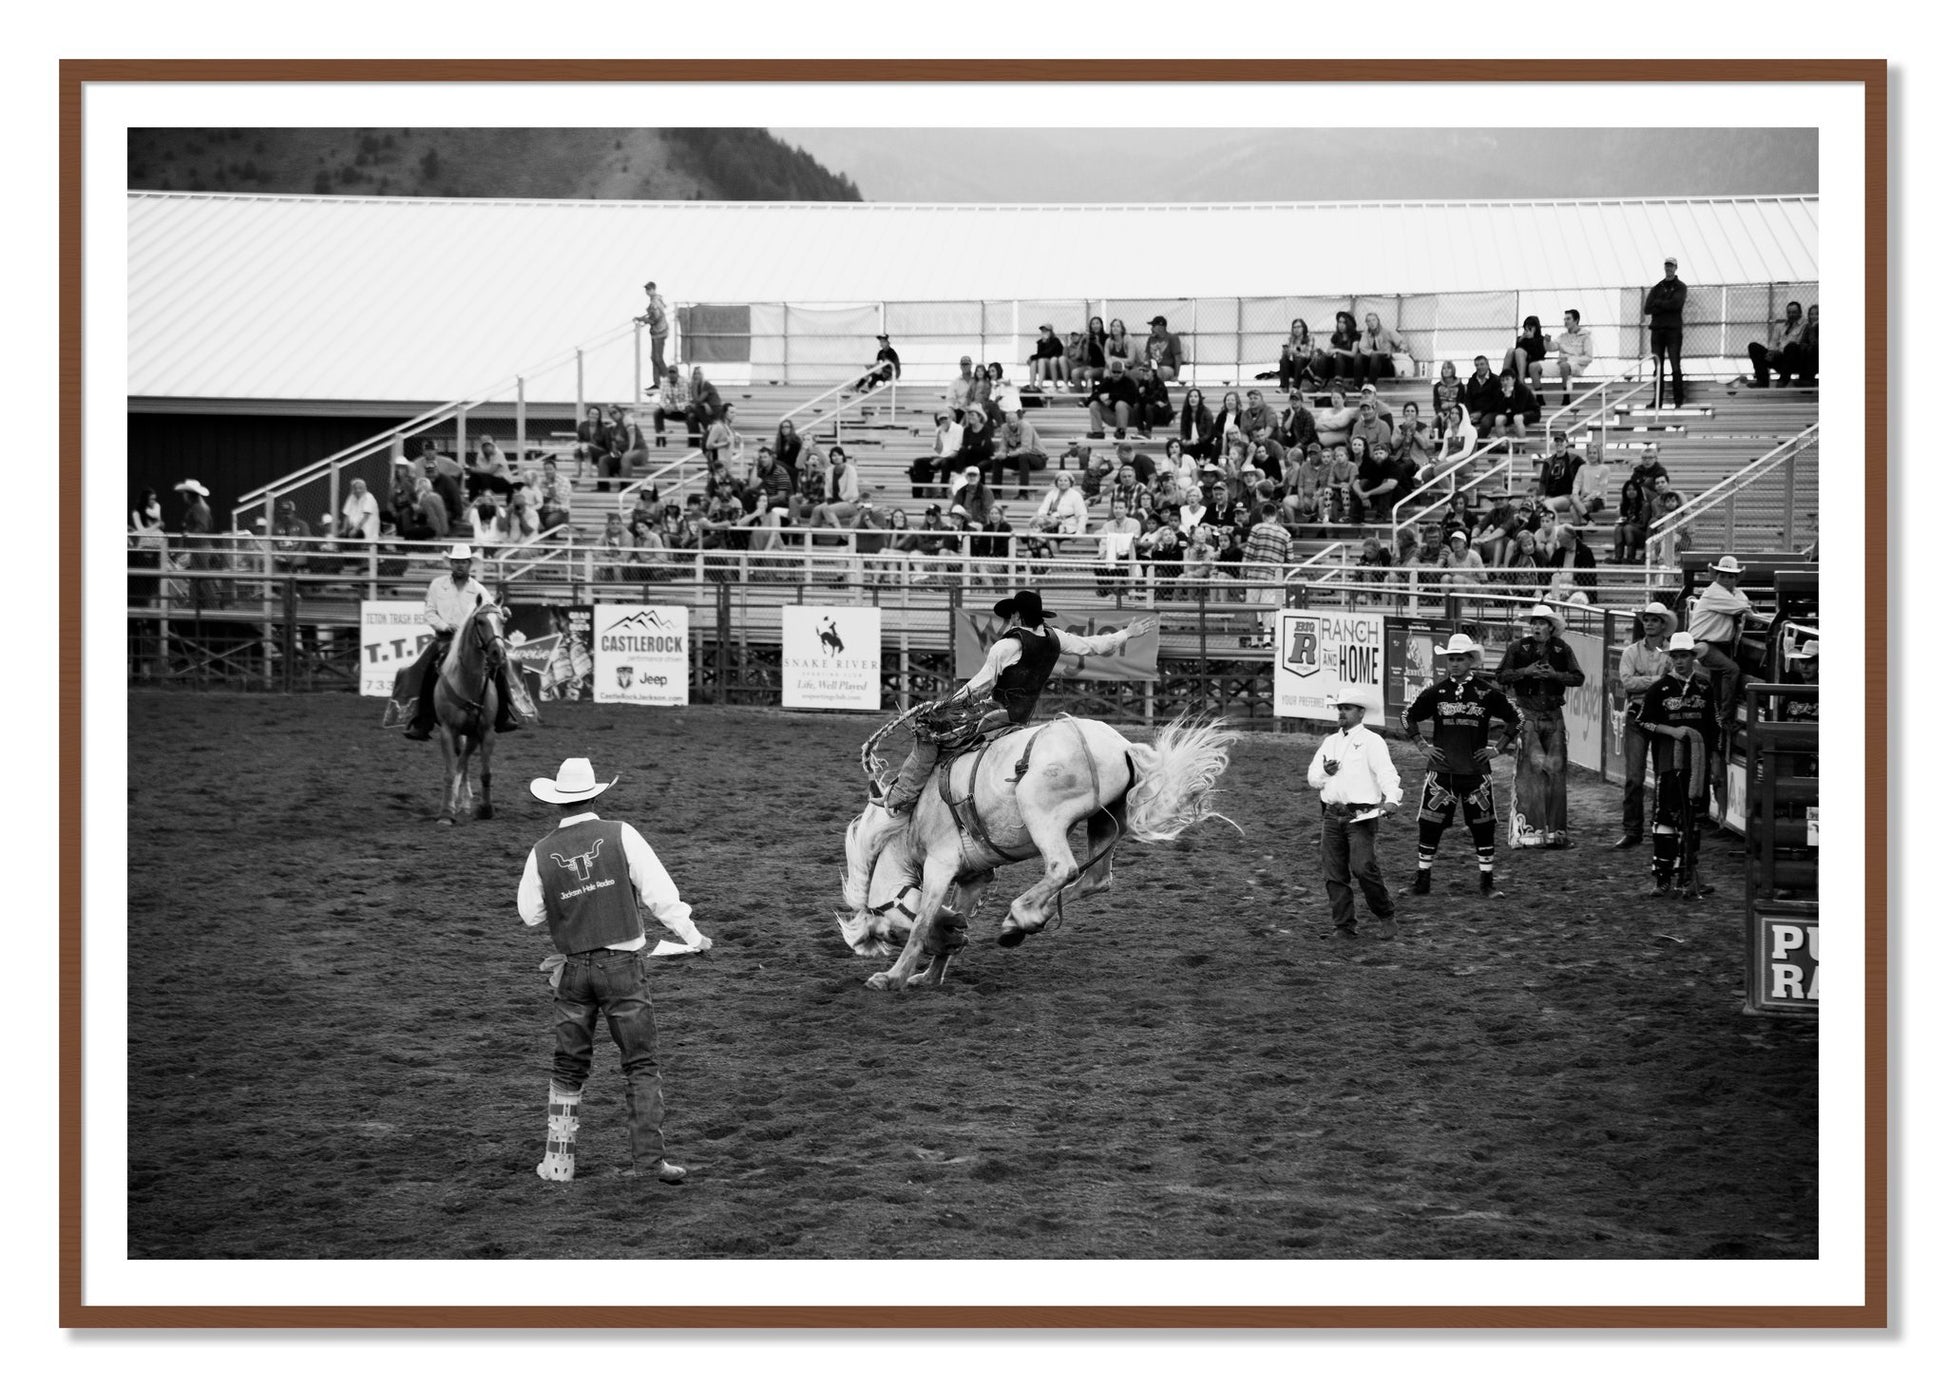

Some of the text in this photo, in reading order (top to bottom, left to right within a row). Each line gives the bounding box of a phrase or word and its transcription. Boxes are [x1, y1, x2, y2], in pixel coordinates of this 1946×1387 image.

[1295, 621, 1316, 633] BIG
[1321, 618, 1379, 644] RANCH
[601, 635, 683, 653] CASTLEROCK
[1287, 632, 1317, 665] R
[784, 658, 879, 670] SNAKE RIVER
[1322, 652, 1338, 667] AND
[1339, 645, 1379, 684] HOME
[639, 672, 668, 688] Jeep
[819, 680, 837, 690] Well
[838, 681, 868, 692] Played
[1281, 694, 1298, 706] YOUR
[561, 879, 615, 900] Jackson Hole Rodeo
